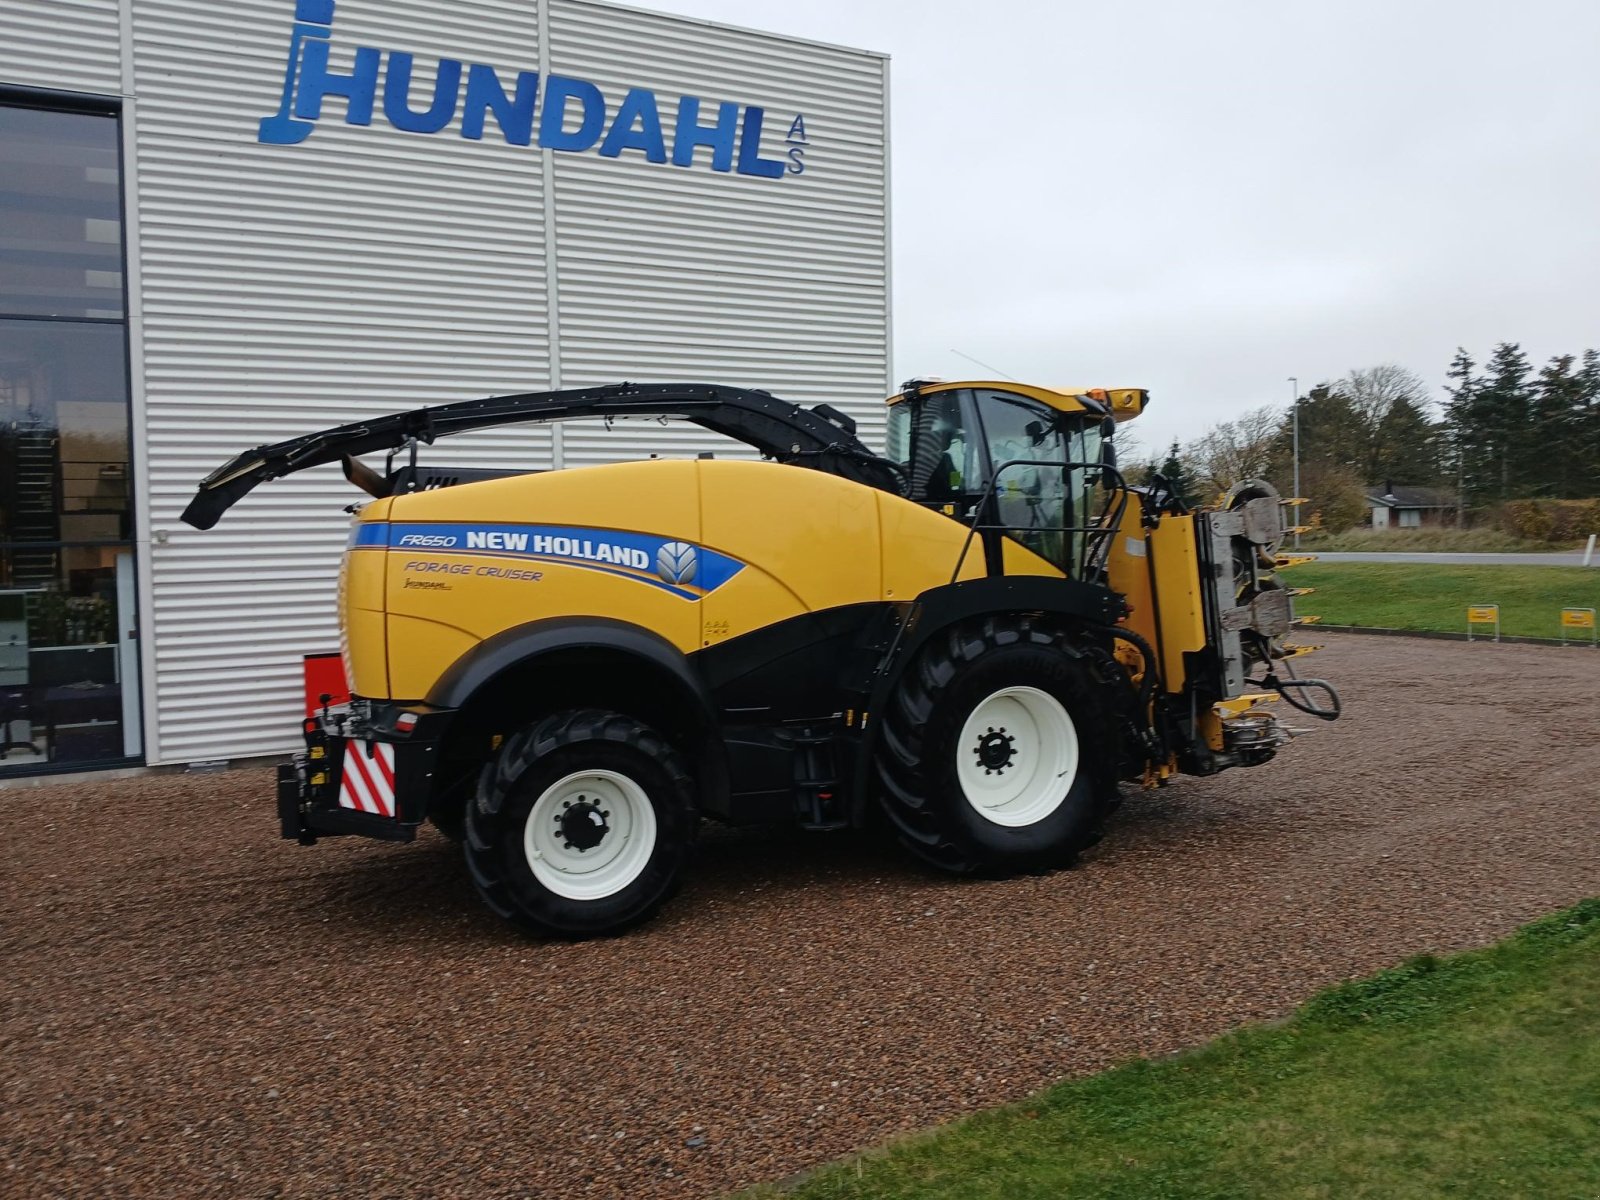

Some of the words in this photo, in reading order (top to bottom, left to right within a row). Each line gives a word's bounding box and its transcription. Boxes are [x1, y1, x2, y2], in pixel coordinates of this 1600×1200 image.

[400, 534, 457, 547] FR650
[466, 531, 528, 551] NEW
[534, 535, 650, 570] HOLLAND
[404, 561, 474, 575] FORAGE
[475, 566, 544, 582] CRUISER
